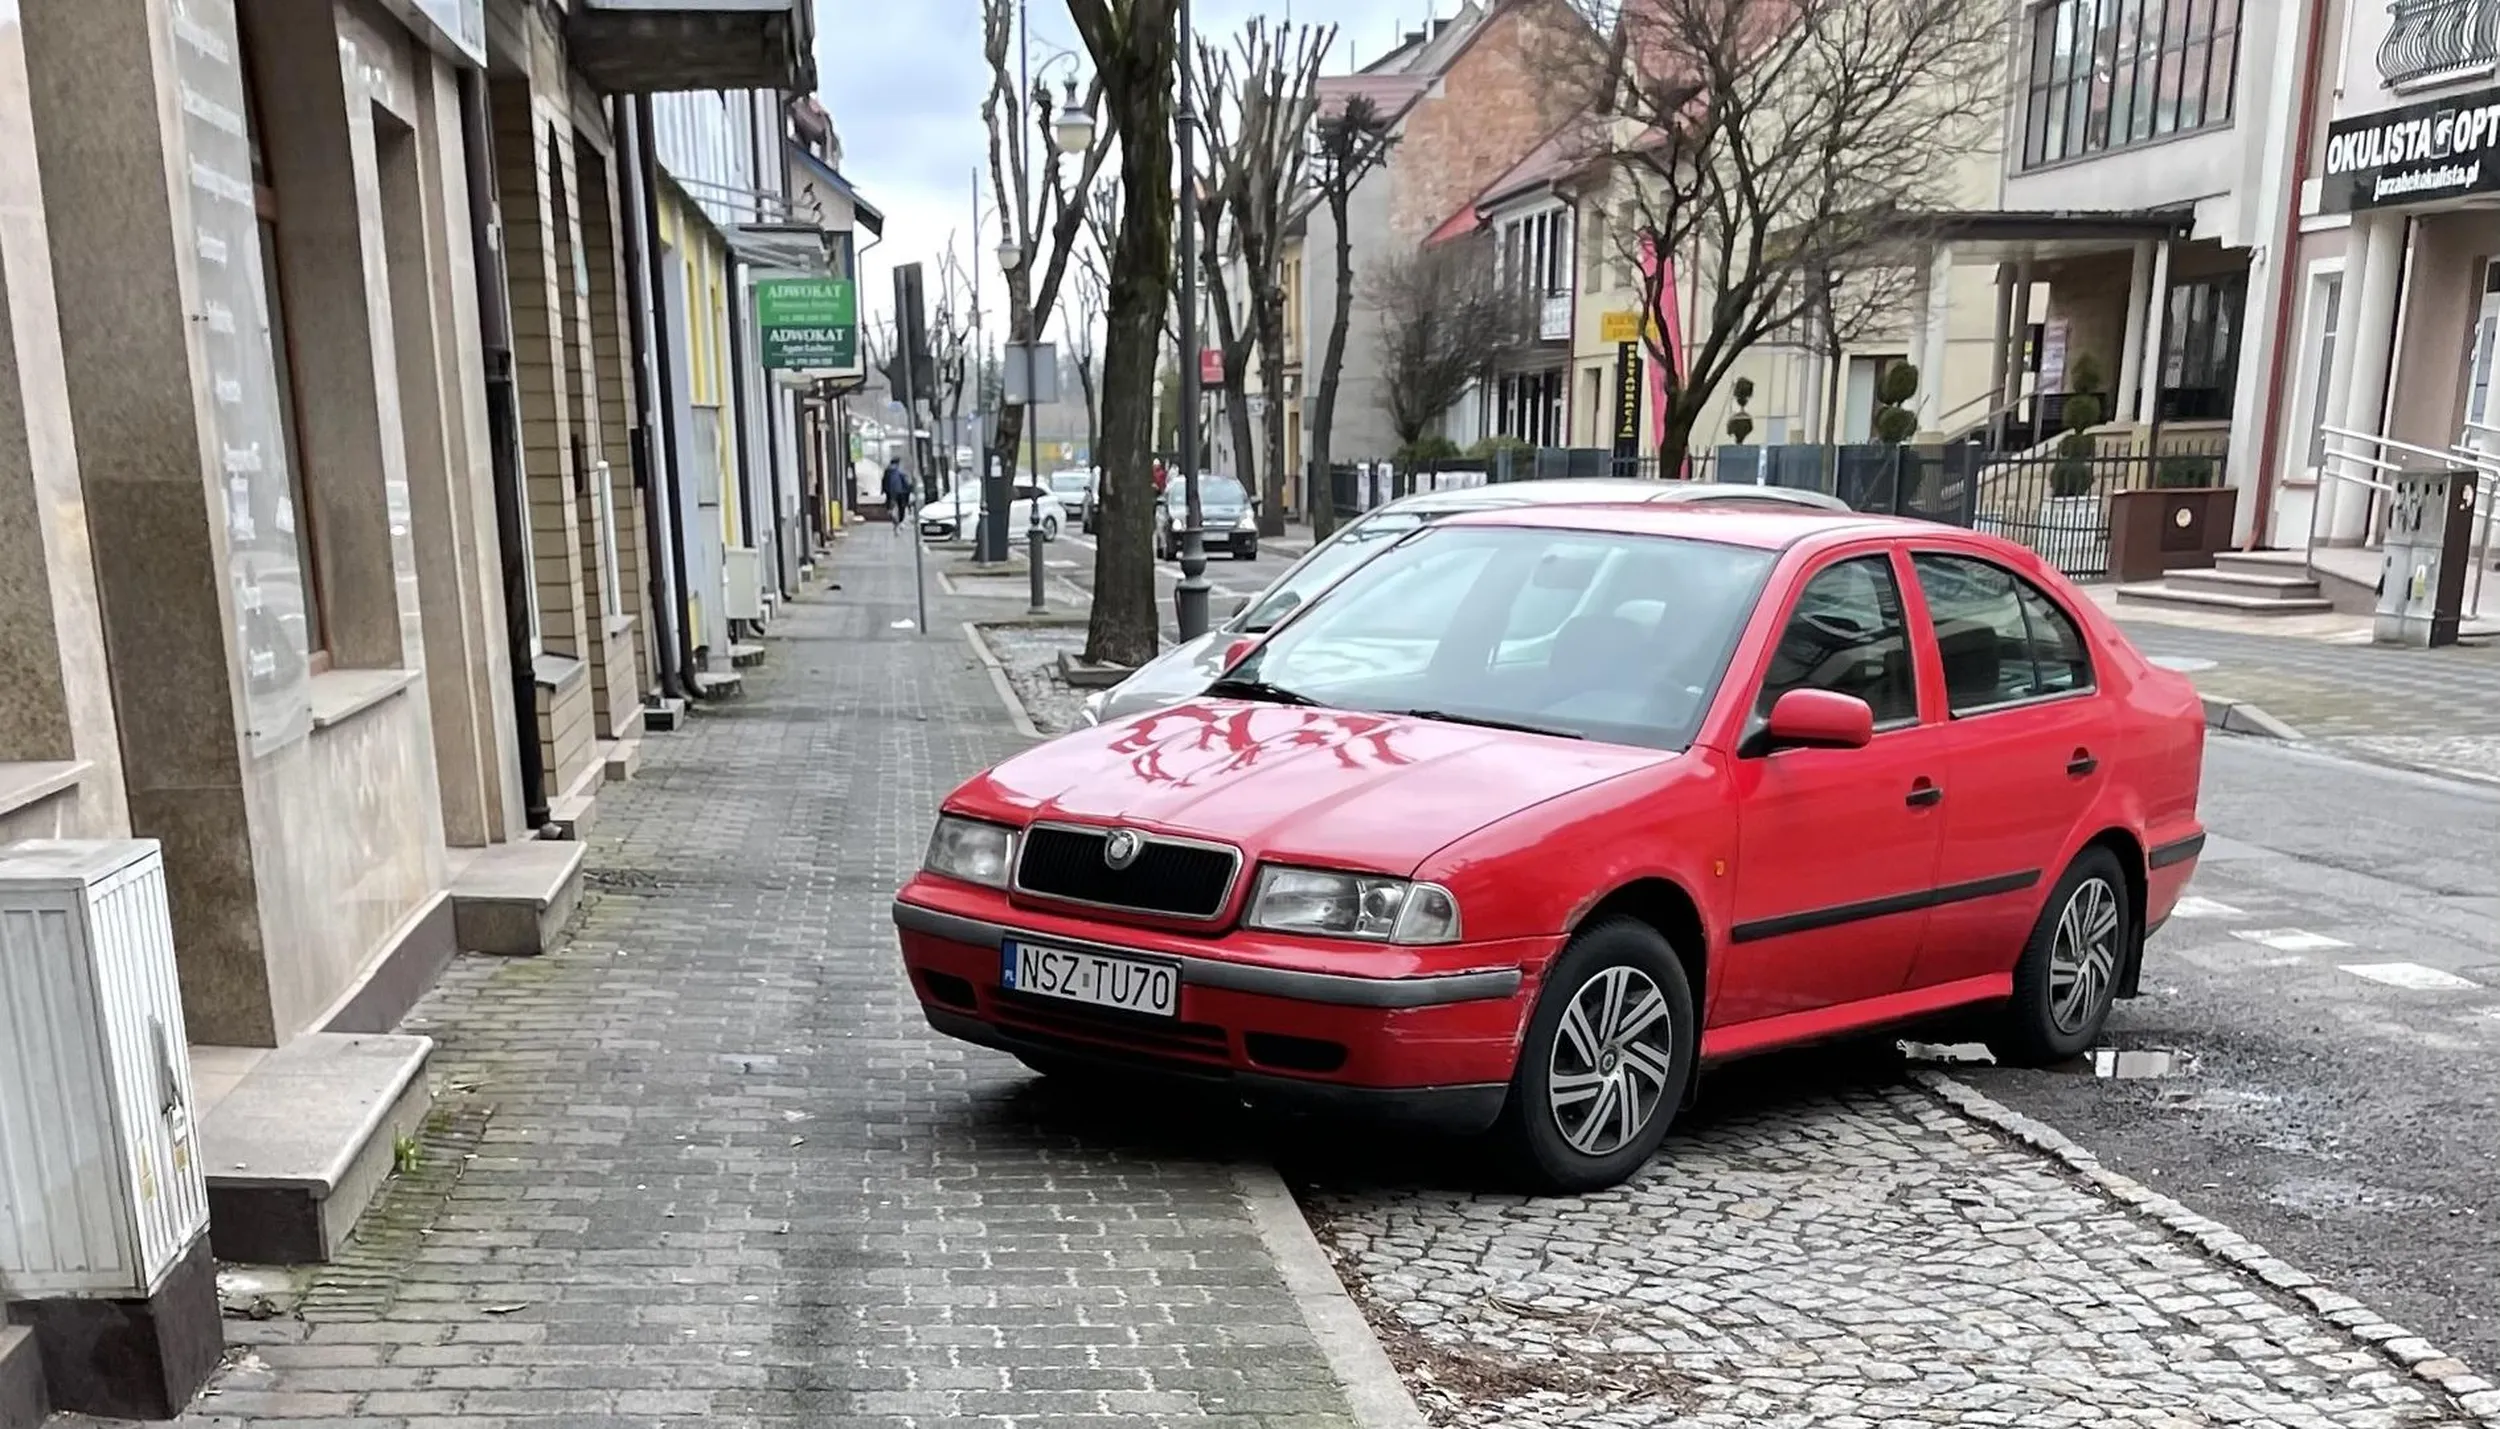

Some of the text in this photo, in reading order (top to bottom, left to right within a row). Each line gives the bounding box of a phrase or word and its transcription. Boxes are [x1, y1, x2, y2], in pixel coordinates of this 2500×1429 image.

[2327, 118, 2431, 174] OKULISTA
[768, 285, 842, 298] ADWOKAT
[770, 328, 844, 341] ADWOKAT
[1004, 969, 1015, 982] PL
[1022, 948, 1170, 1010] NSZ TU70
